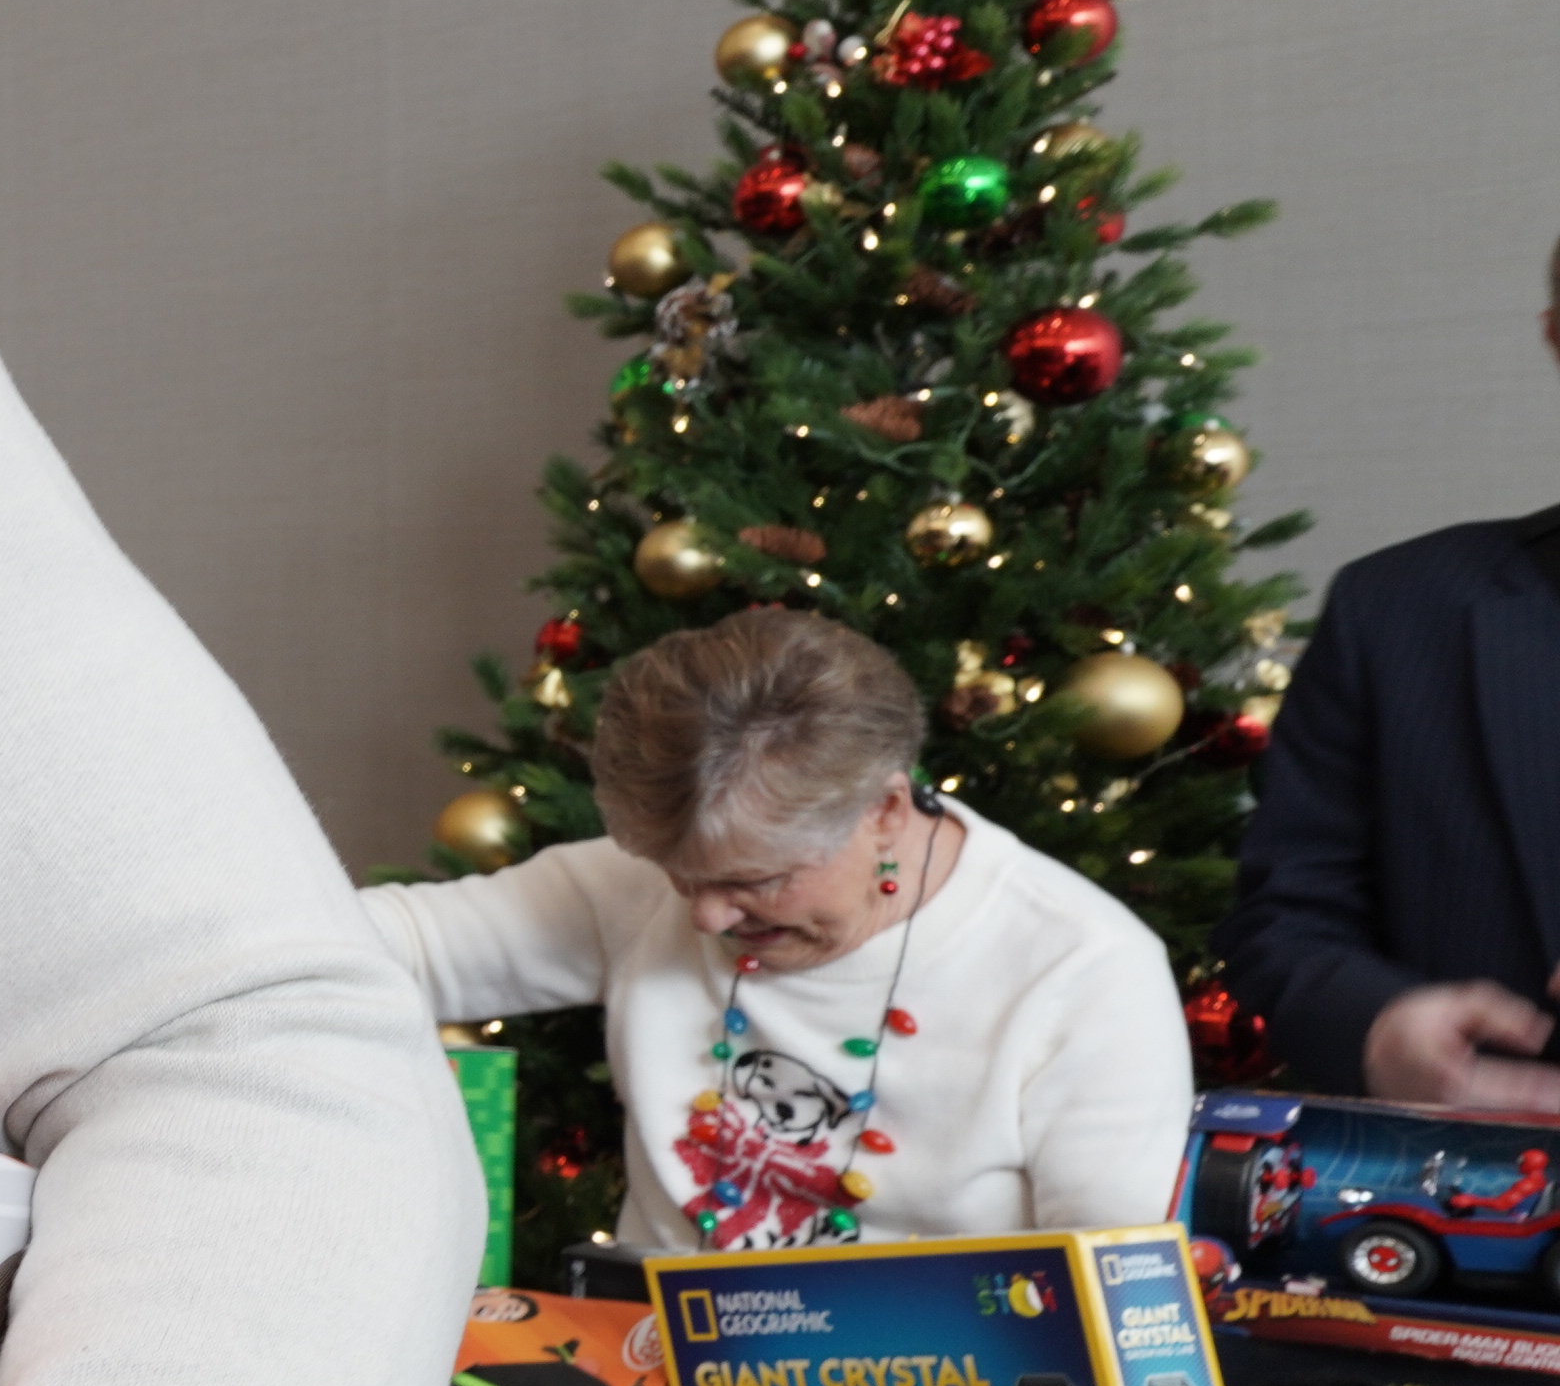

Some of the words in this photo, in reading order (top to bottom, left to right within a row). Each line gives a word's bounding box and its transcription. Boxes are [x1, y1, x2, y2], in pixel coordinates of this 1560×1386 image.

[716, 1290, 806, 1313] NATIONAL
[719, 1310, 833, 1336] GEOGRAPHIC
[1117, 1322, 1196, 1349] CRYSTAL
